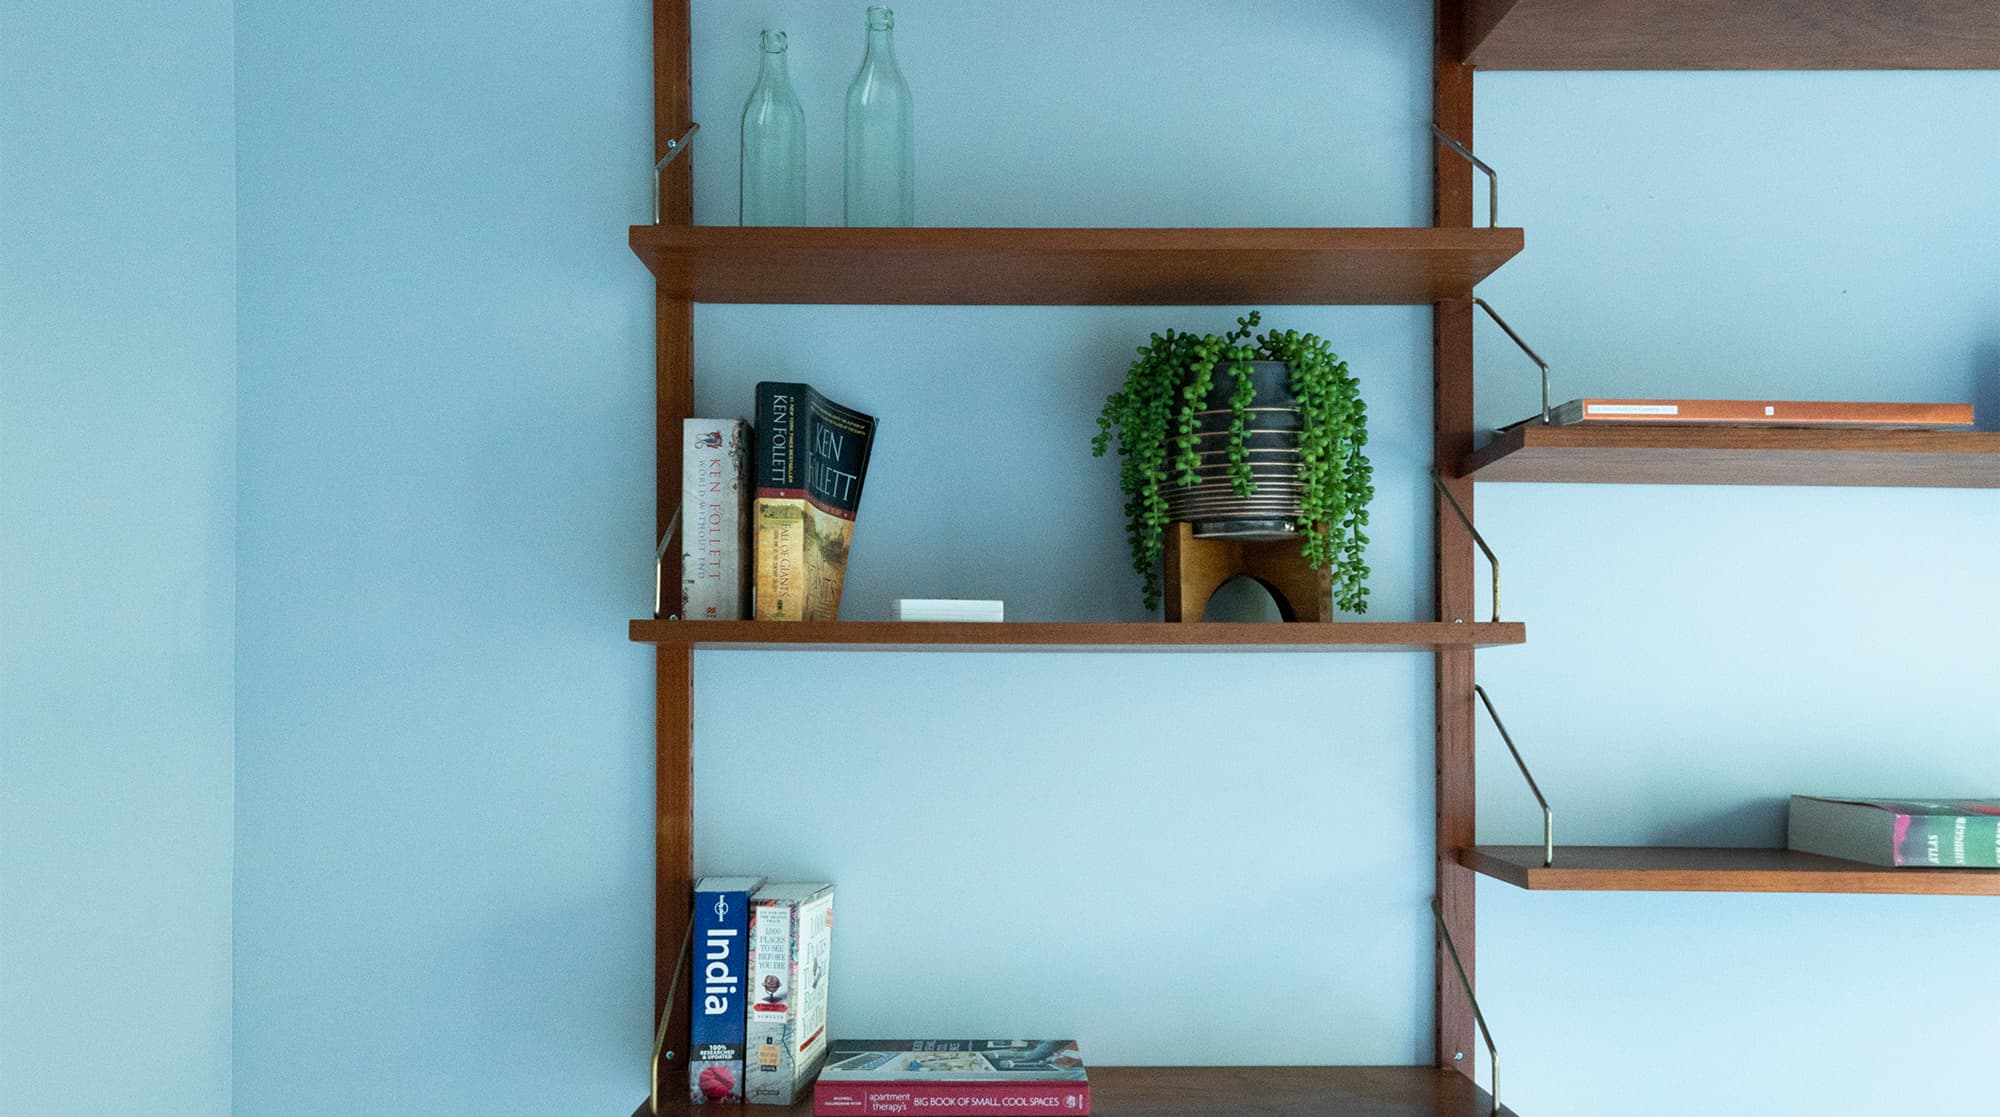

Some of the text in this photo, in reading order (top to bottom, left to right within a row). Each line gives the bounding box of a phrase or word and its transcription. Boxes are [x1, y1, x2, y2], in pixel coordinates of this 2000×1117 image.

[771, 394, 788, 485] KEN FOLLETT
[816, 421, 844, 462] KEN
[698, 459, 706, 580] WORLD WITHOUT END
[709, 458, 721, 580] KEN FOLLETT
[779, 523, 791, 598] FALL OF GIANTS
[1928, 834, 1939, 865] ATLAS
[759, 936, 786, 944] PLACES
[760, 944, 784, 952] TO SEE
[758, 953, 786, 961] BEFORE
[758, 962, 785, 970] YOU DIE
[704, 929, 738, 1015] India
[869, 1093, 910, 1103] apartment
[872, 1101, 907, 1113] therapy's
[913, 1097, 929, 1106] BIG
[930, 1097, 956, 1106] BOOK
[957, 1097, 970, 1106] OF
[1002, 1097, 1028, 1107] COOL
[1029, 1097, 1060, 1107] SPACES
